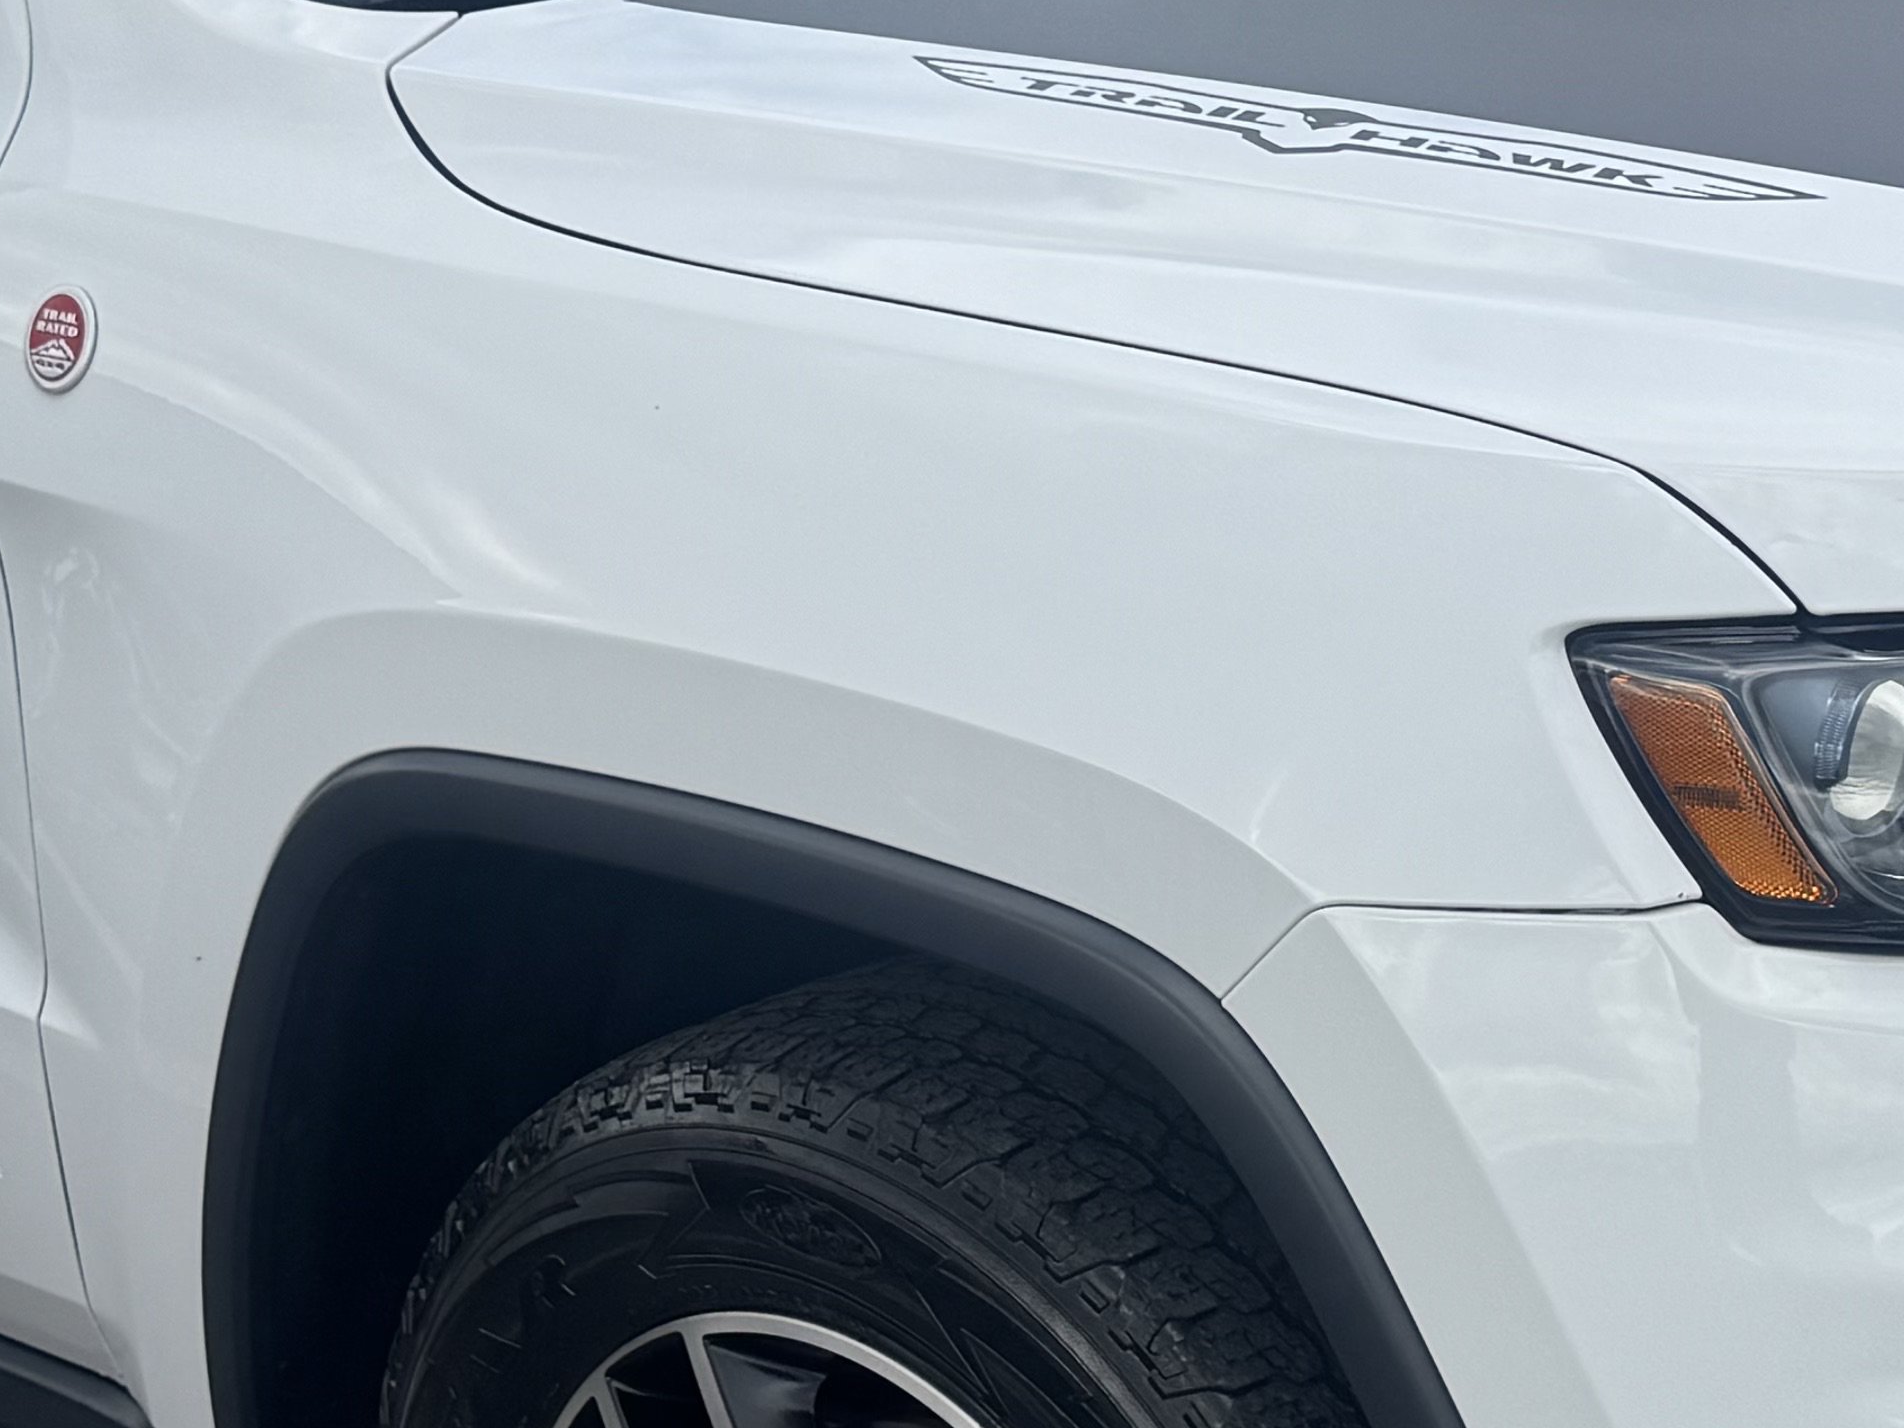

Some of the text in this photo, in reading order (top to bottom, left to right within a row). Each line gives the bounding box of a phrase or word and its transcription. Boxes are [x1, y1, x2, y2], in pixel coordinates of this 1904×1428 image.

[1018, 75, 1287, 129] TRAIL
[42, 308, 78, 325] TRAIL
[35, 319, 79, 338] RATED
